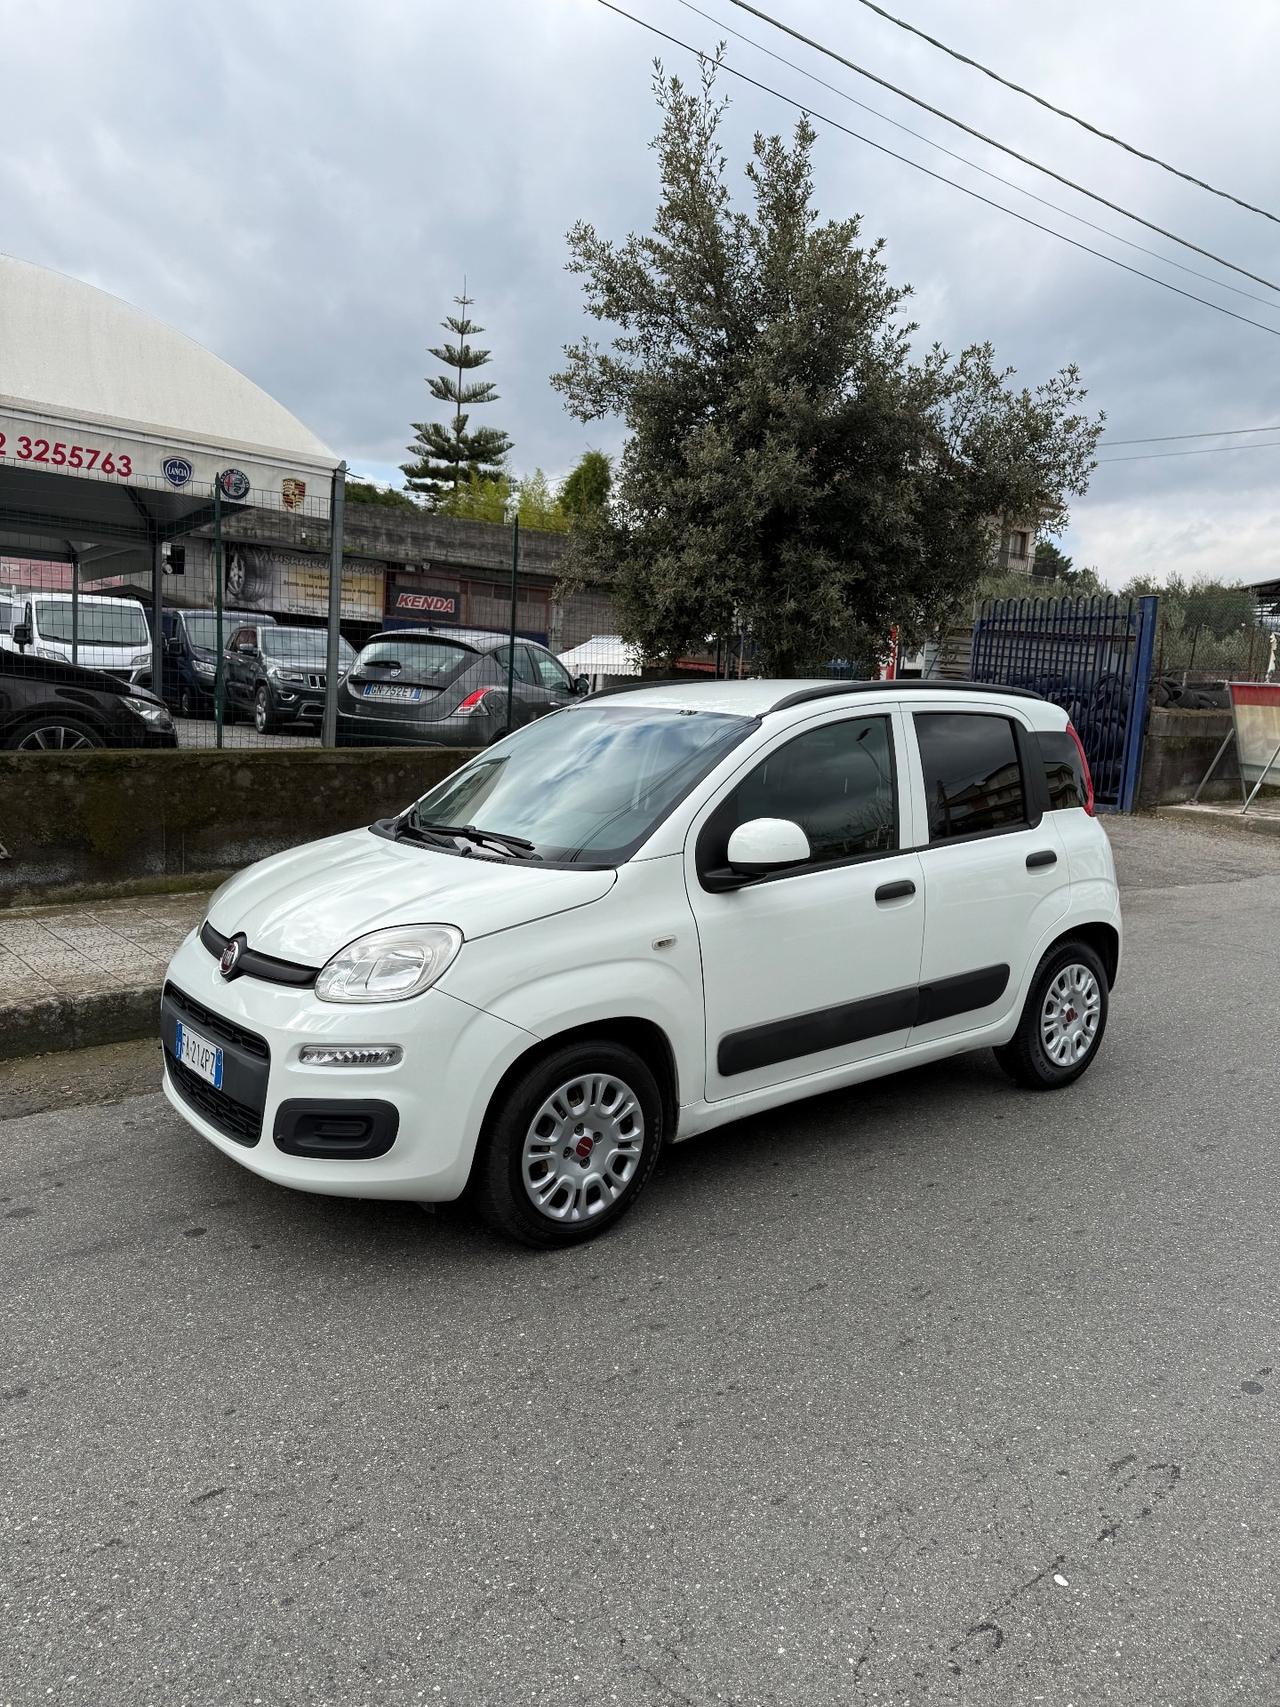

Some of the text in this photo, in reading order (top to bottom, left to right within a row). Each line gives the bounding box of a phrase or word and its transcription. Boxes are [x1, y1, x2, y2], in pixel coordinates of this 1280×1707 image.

[16, 436, 132, 477] 3255763
[168, 466, 187, 477] LANCIA
[396, 593, 455, 613] KENDA
